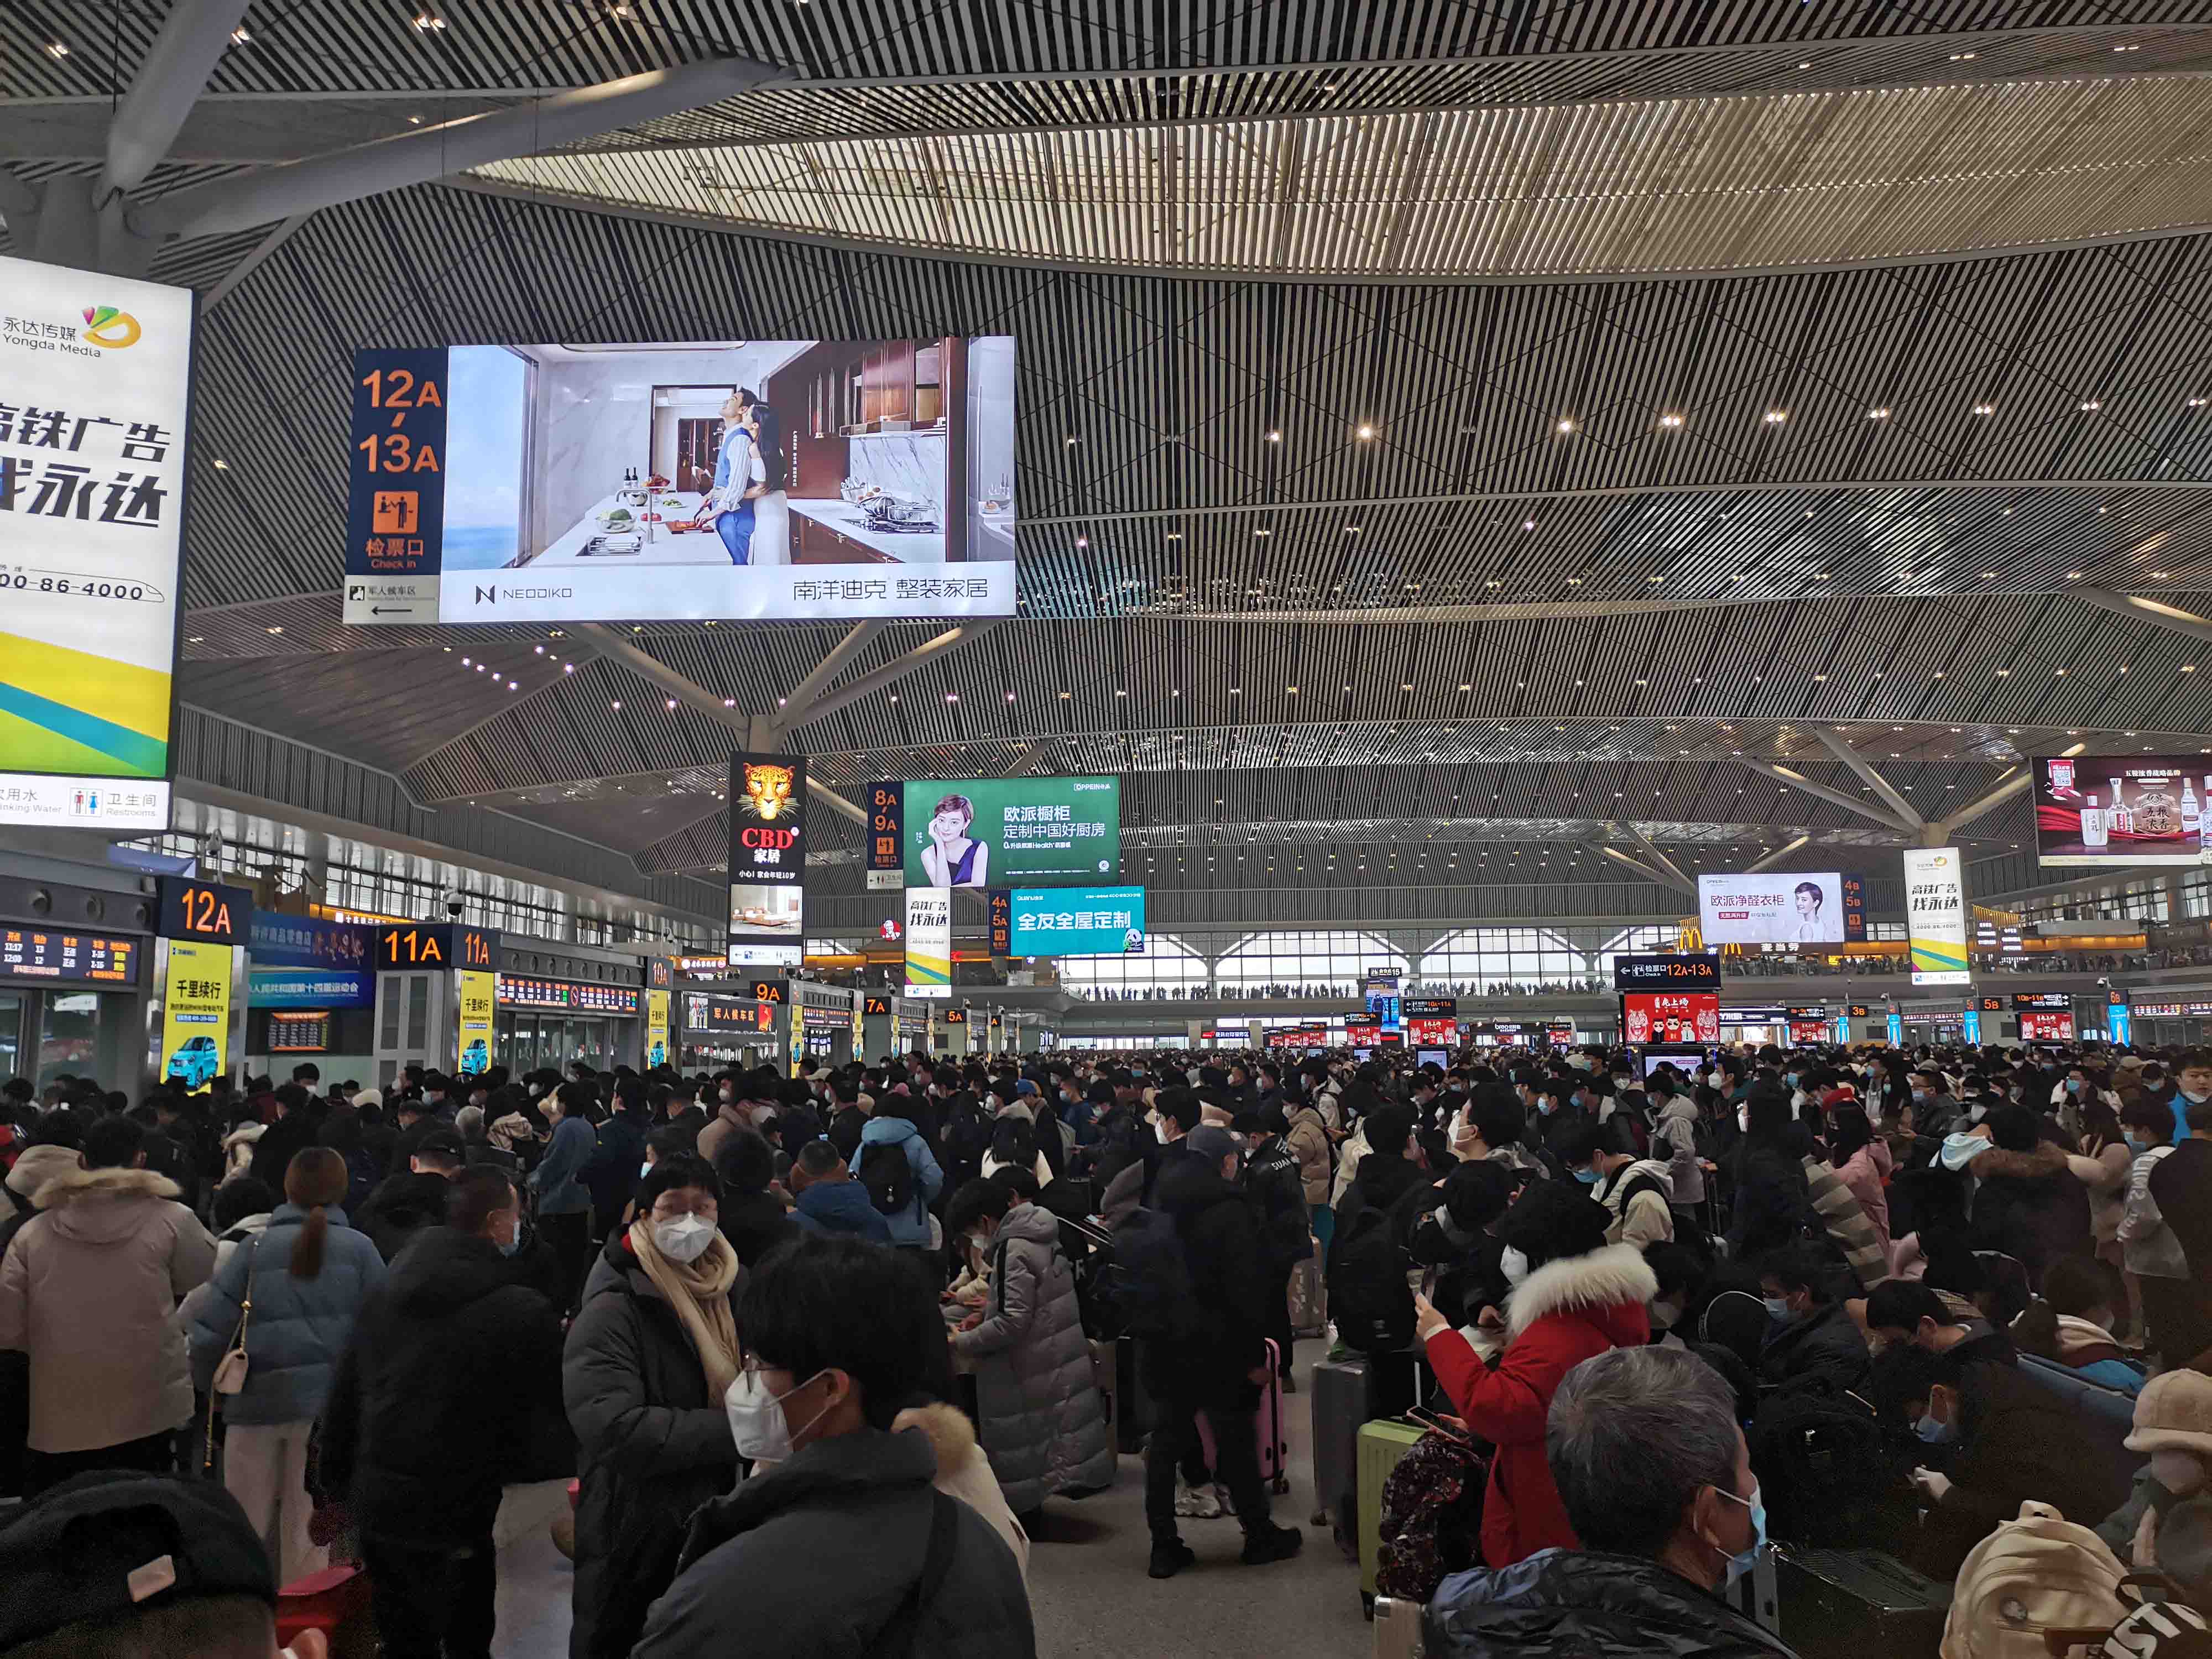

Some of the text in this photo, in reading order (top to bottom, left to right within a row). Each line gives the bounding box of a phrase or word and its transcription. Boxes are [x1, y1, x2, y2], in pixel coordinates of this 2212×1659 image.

[3, 317, 76, 341] 永达传媒
[3, 333, 101, 357] Yongda Media
[363, 369, 441, 408] 12A
[359, 434, 439, 473] 13A
[366, 538, 424, 557] 检票口
[503, 587, 572, 599] NEODIKO
[793, 578, 988, 601] 南洋迪克 整装家居
[107, 793, 157, 807] 卫生间
[875, 789, 897, 806] 8A
[33, 805, 62, 813] Water
[106, 808, 156, 817] Restrooms
[1004, 805, 1071, 822] 欧派橱柜
[875, 815, 897, 831] 9A
[1003, 822, 1105, 839] 定制中国好厨房
[742, 827, 793, 849] CBD
[754, 848, 781, 864] 家居
[1912, 883, 1958, 895] 高铁广告
[911, 901, 947, 911] 高铁广告
[992, 895, 1008, 907] 4A
[1710, 894, 1785, 907] 欧派净醛衣柜
[1912, 896, 1959, 911] 找永达
[181, 888, 232, 934] 12A
[910, 913, 947, 927] 找永达
[992, 915, 1008, 926] 5A
[1018, 911, 1131, 931] 全友全屋定制
[384, 930, 442, 962] 11A
[465, 932, 490, 965] 11A
[1761, 942, 1799, 952] 麦当劳
[653, 962, 668, 986] 10A
[1667, 964, 1712, 976] 12A-13A
[176, 979, 221, 999] 千里续行
[757, 983, 780, 1000] 9A
[2110, 990, 2121, 1003] 6B
[867, 999, 885, 1013] 7A
[1853, 1006, 1865, 1015] 3B
[1984, 999, 2000, 1010] 5B
[948, 1011, 962, 1022] 5A
